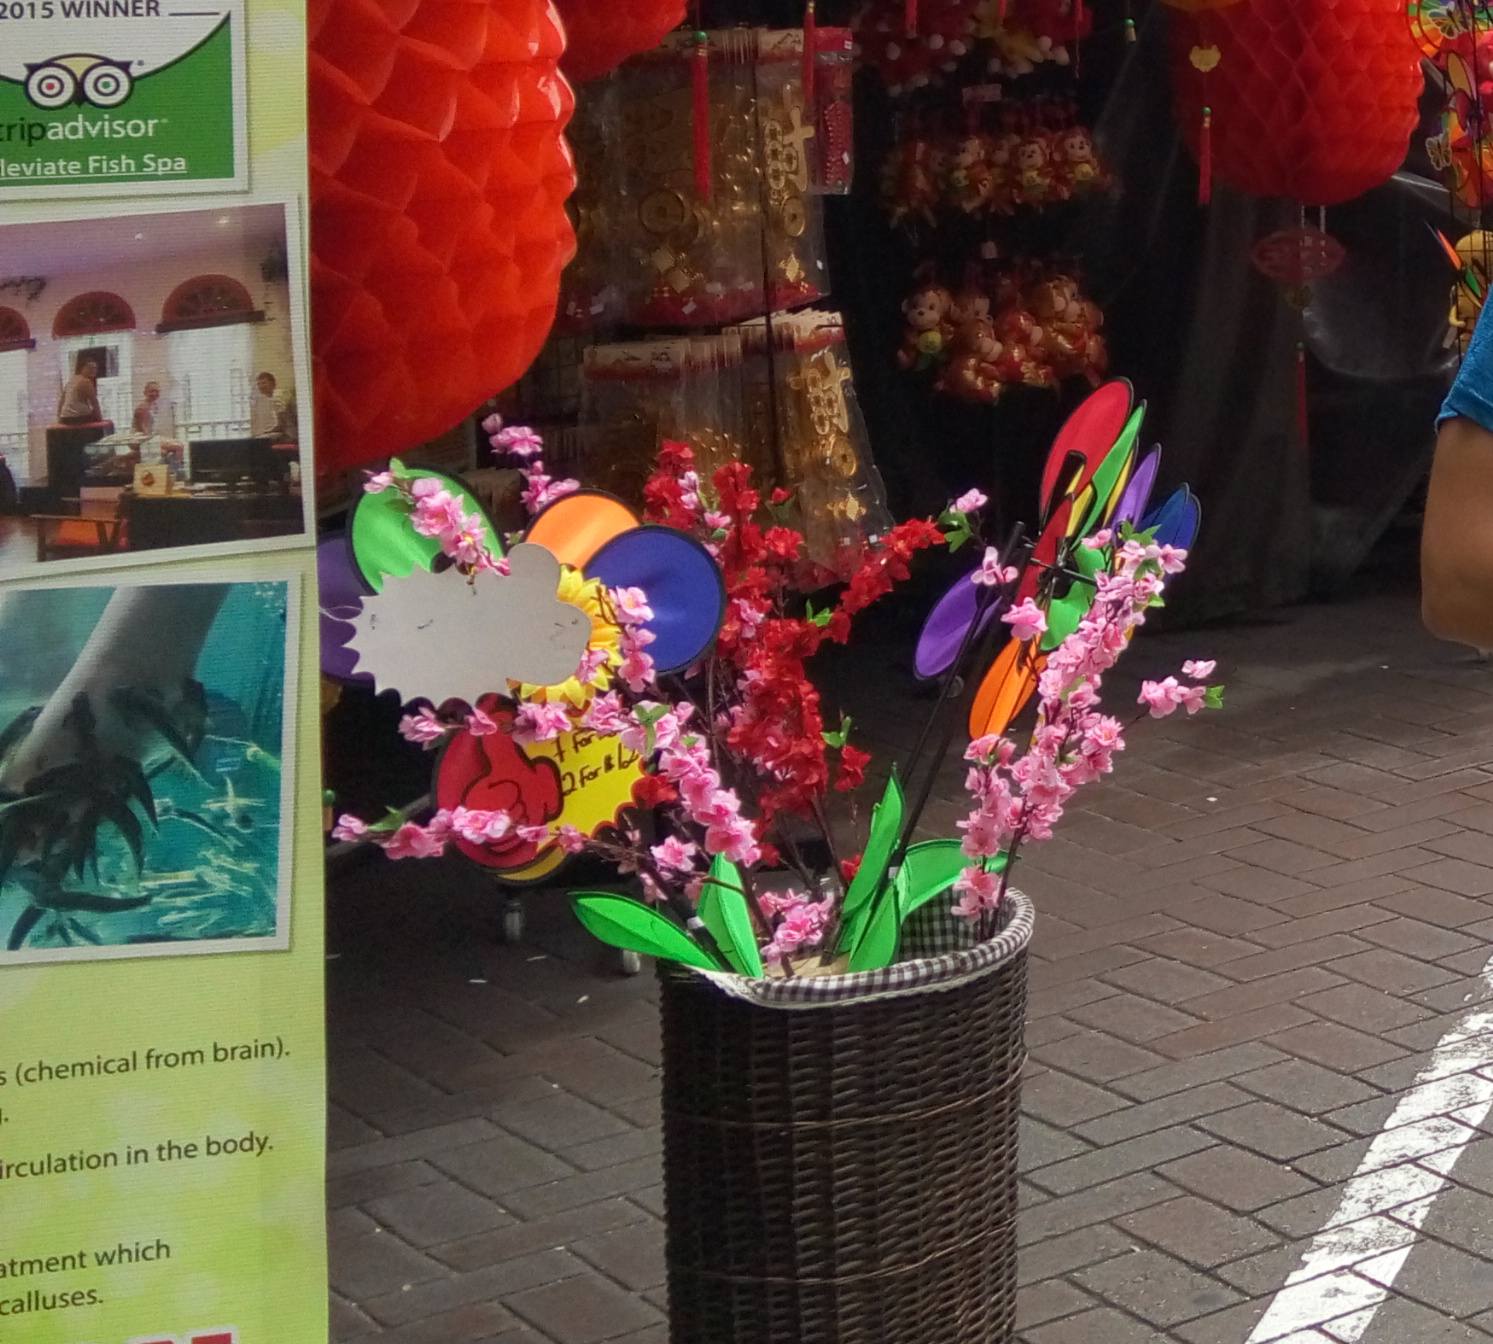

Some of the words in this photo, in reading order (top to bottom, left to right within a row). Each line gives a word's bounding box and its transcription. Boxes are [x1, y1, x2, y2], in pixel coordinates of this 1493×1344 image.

[60, 0, 161, 18] WINNER
[88, 154, 136, 174] Fish
[143, 153, 187, 176] Spa
[15, 1050, 138, 1087] (chemical
[145, 1047, 206, 1072] from
[213, 1036, 291, 1064] brain).
[126, 1145, 149, 1165] in
[157, 1139, 199, 1162] the
[205, 1130, 275, 1158] body.
[95, 1239, 171, 1267] which
[0, 1288, 104, 1316] calluses.
